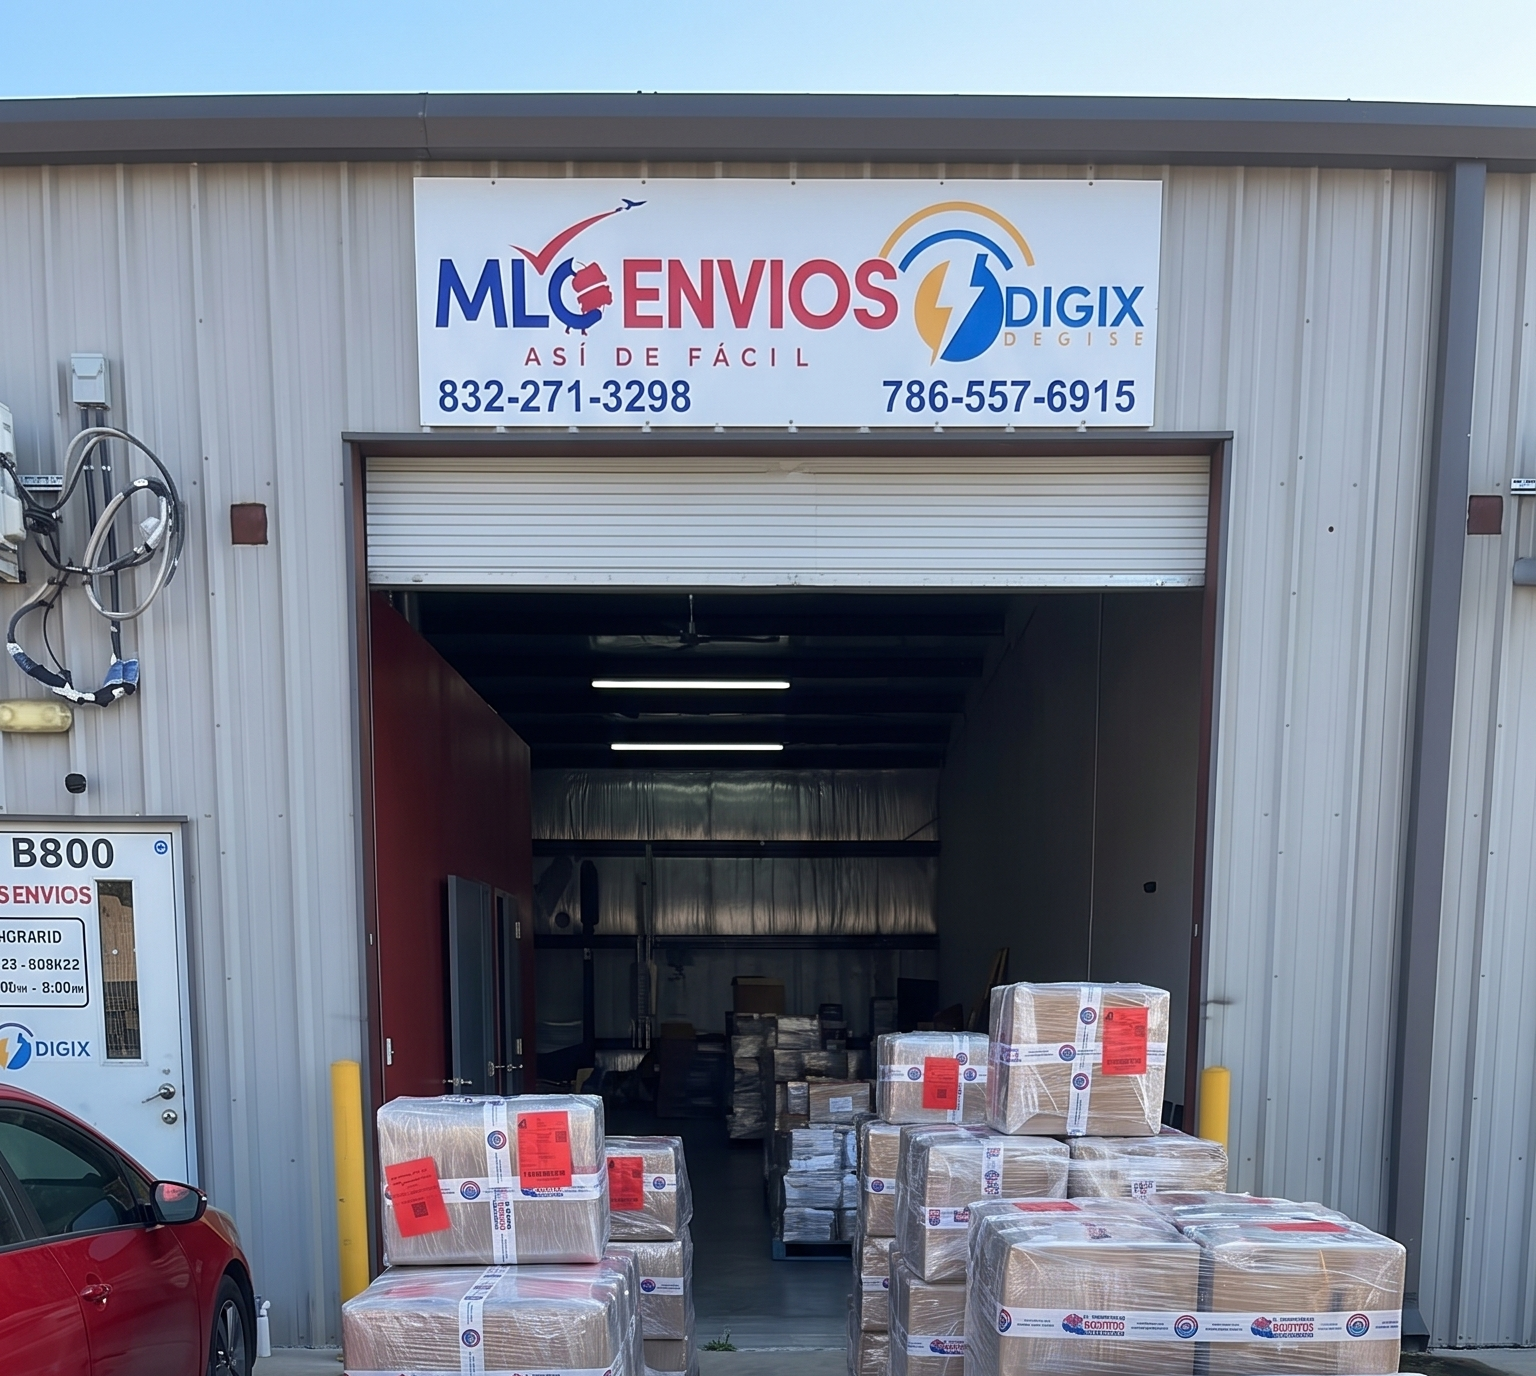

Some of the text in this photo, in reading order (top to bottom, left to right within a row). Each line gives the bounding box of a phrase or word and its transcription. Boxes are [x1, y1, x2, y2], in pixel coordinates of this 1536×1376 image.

[623, 258, 899, 330] ENVIOS
[1004, 285, 1145, 328] DIGIX
[524, 342, 810, 367] ASÍ DE FÁCIL
[1003, 331, 1144, 347] DEGISE
[438, 380, 691, 413] 832-271-3298
[882, 379, 1136, 413] 786-557-6915
[12, 837, 114, 869] B800
[13, 885, 92, 904] ENVIOS
[36, 1041, 91, 1057] DIGIX
